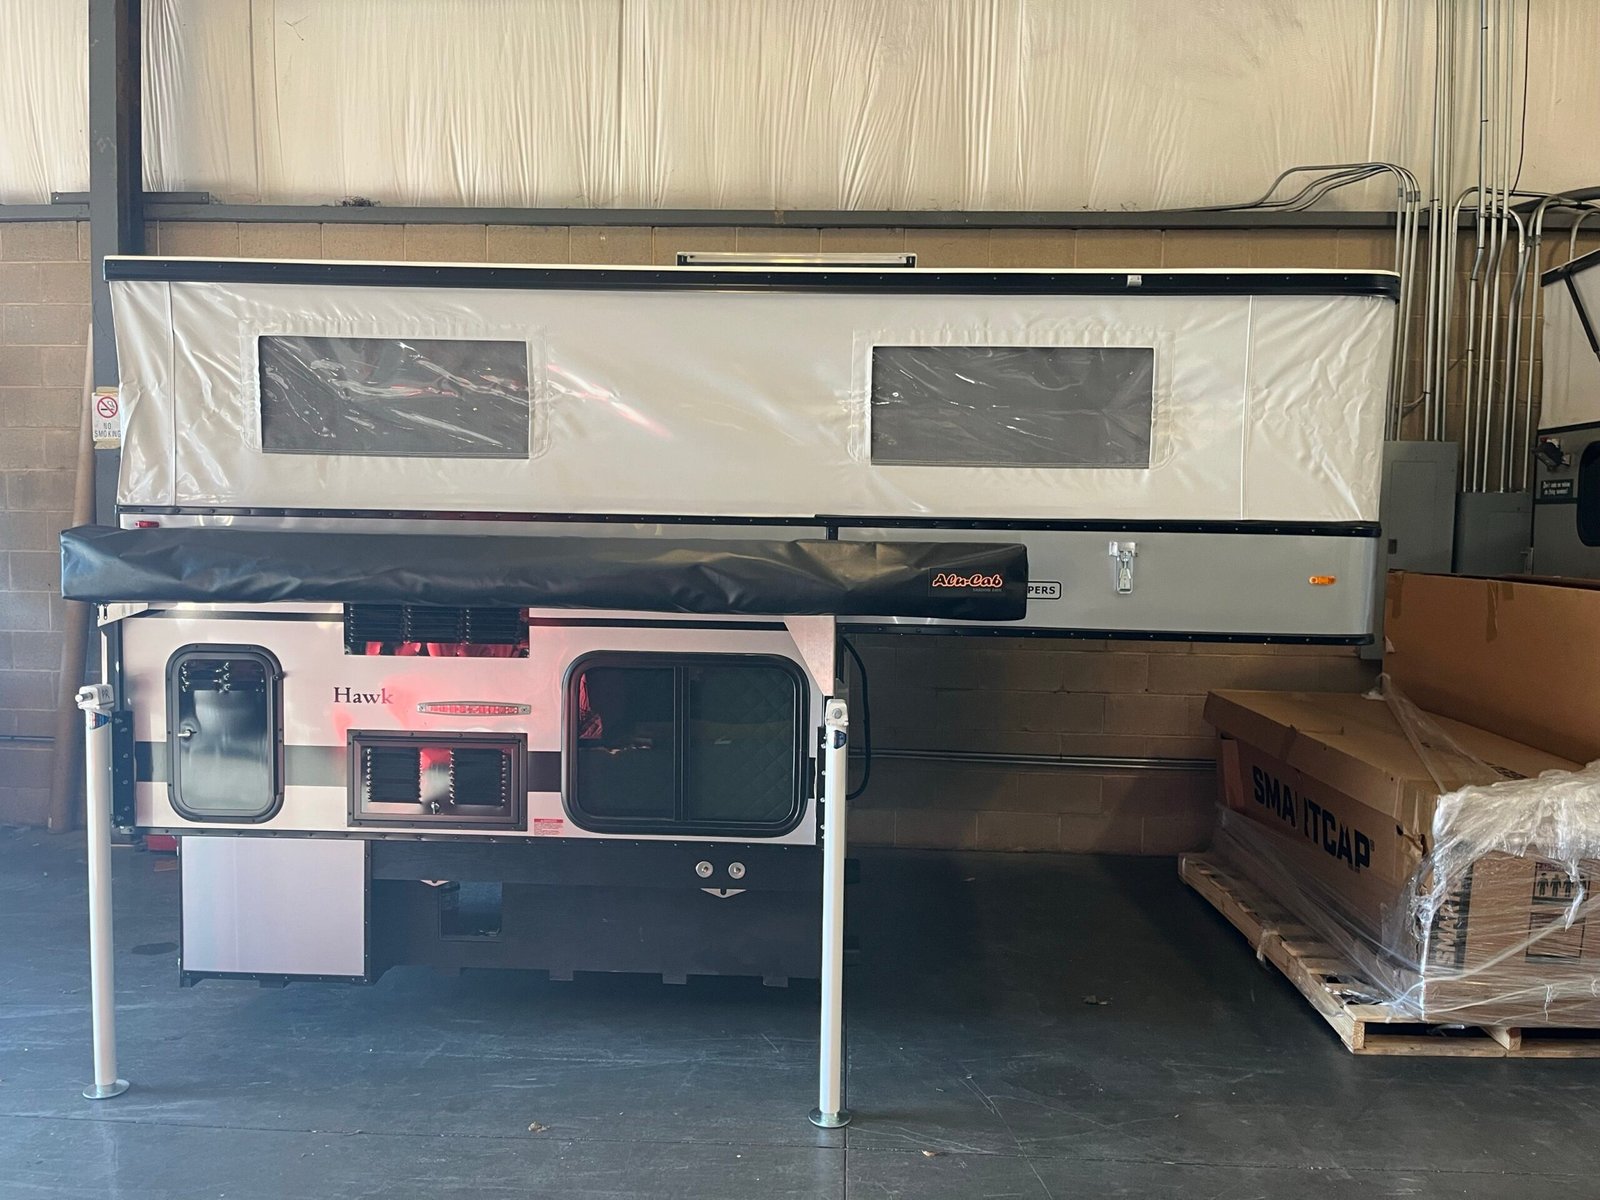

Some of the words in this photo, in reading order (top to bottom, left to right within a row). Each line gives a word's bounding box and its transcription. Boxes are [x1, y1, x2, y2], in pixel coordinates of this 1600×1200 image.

[103, 422, 112, 430] NO
[94, 430, 121, 438] SMOKING
[932, 573, 1003, 588] Alu-Cab
[1027, 585, 1056, 595] PERS
[333, 686, 394, 704] Hawk
